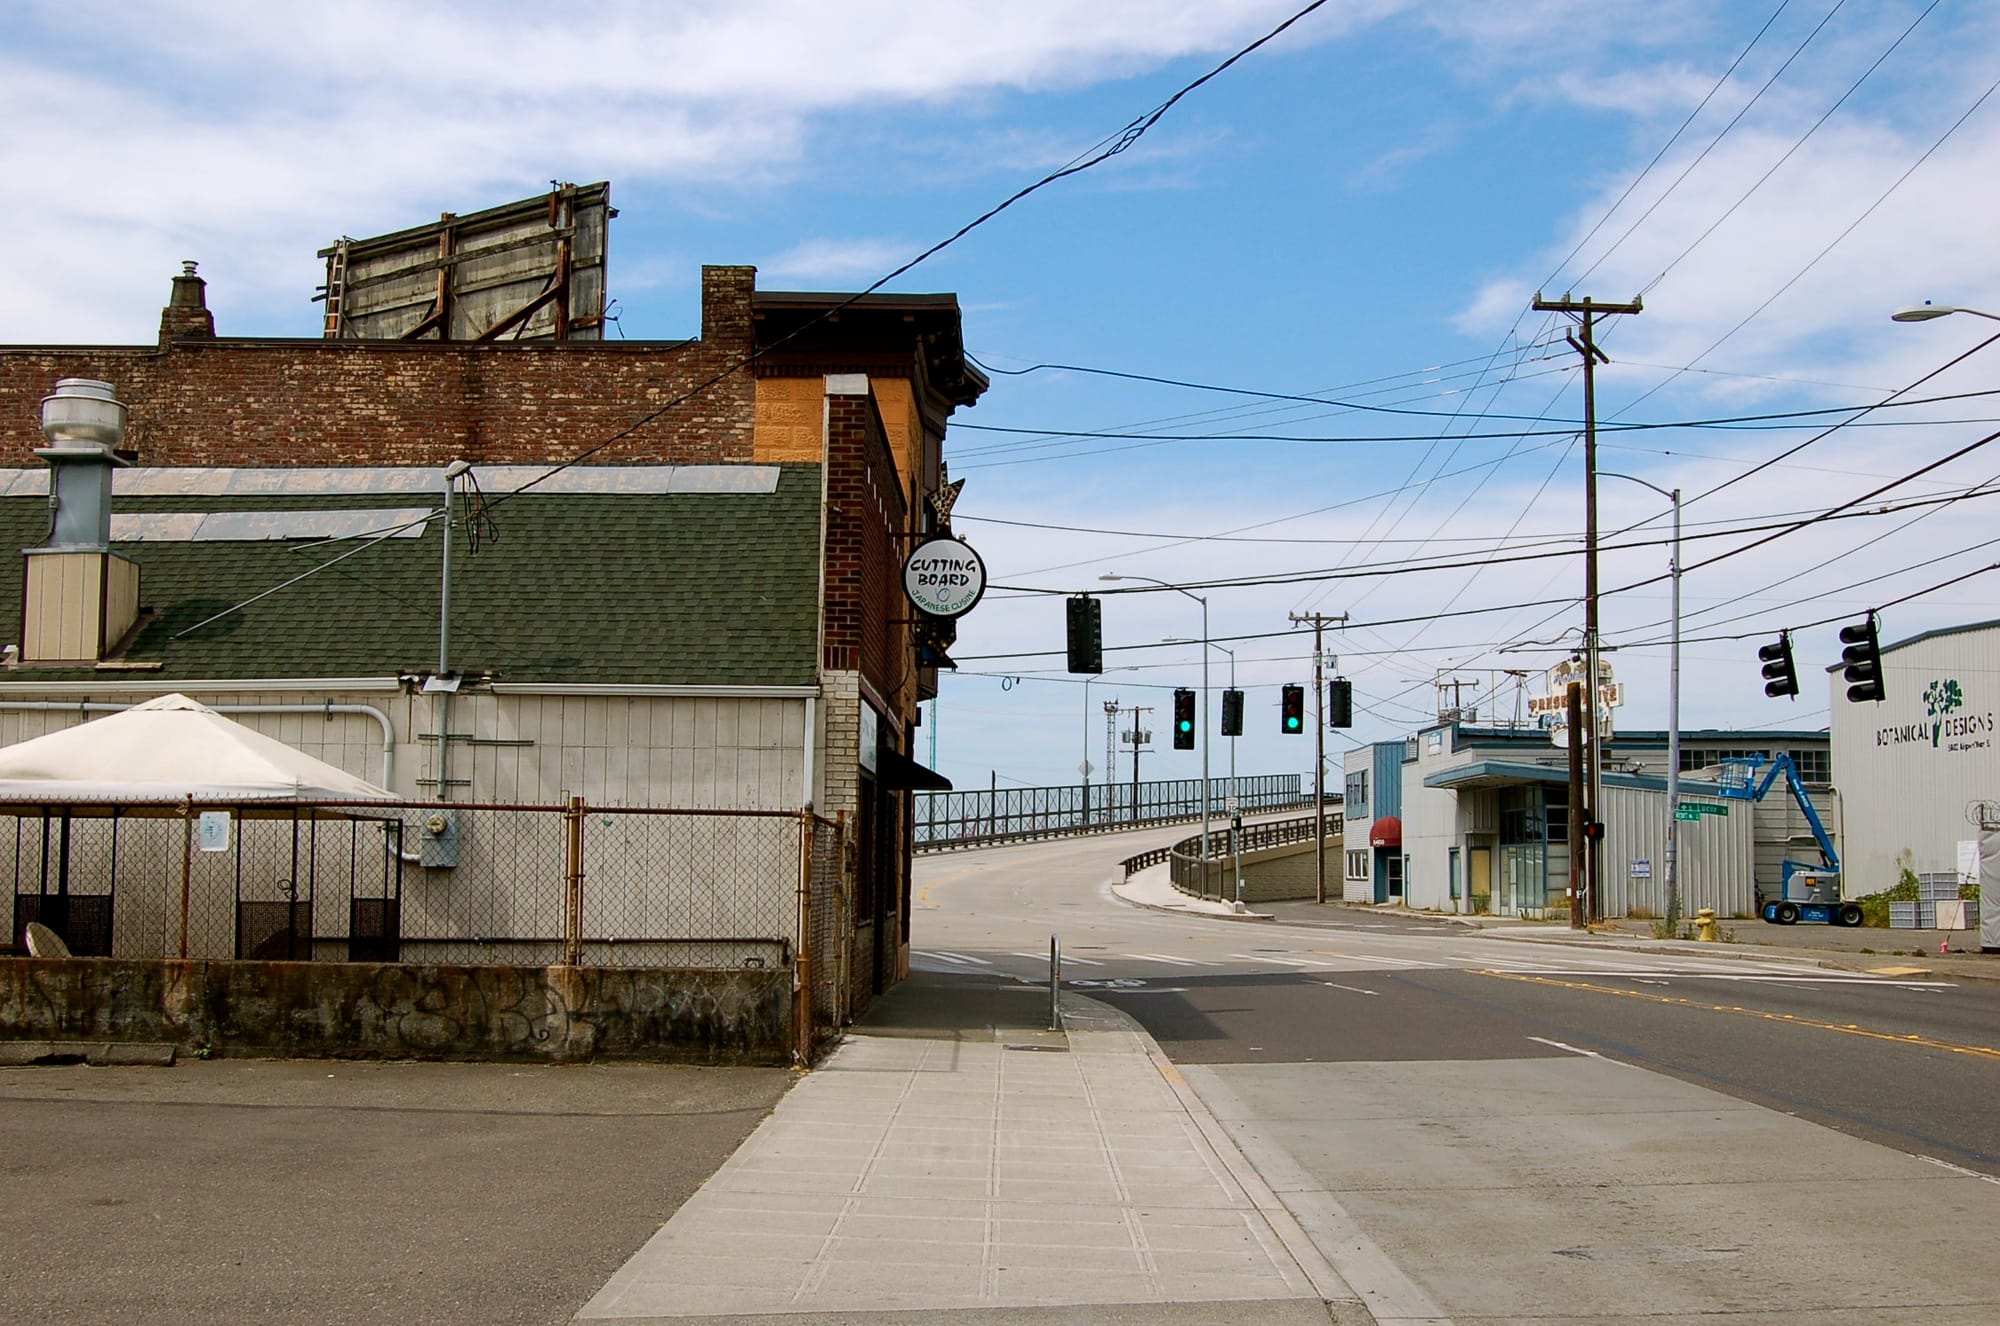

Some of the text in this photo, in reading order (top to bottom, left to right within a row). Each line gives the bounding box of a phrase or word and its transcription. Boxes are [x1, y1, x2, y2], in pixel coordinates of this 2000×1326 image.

[910, 559, 977, 573] CUTTING
[918, 573, 970, 587] BOARD
[911, 589, 951, 612] JAPANESE
[1876, 713, 1994, 747] BOTANICAL DESIGNS
